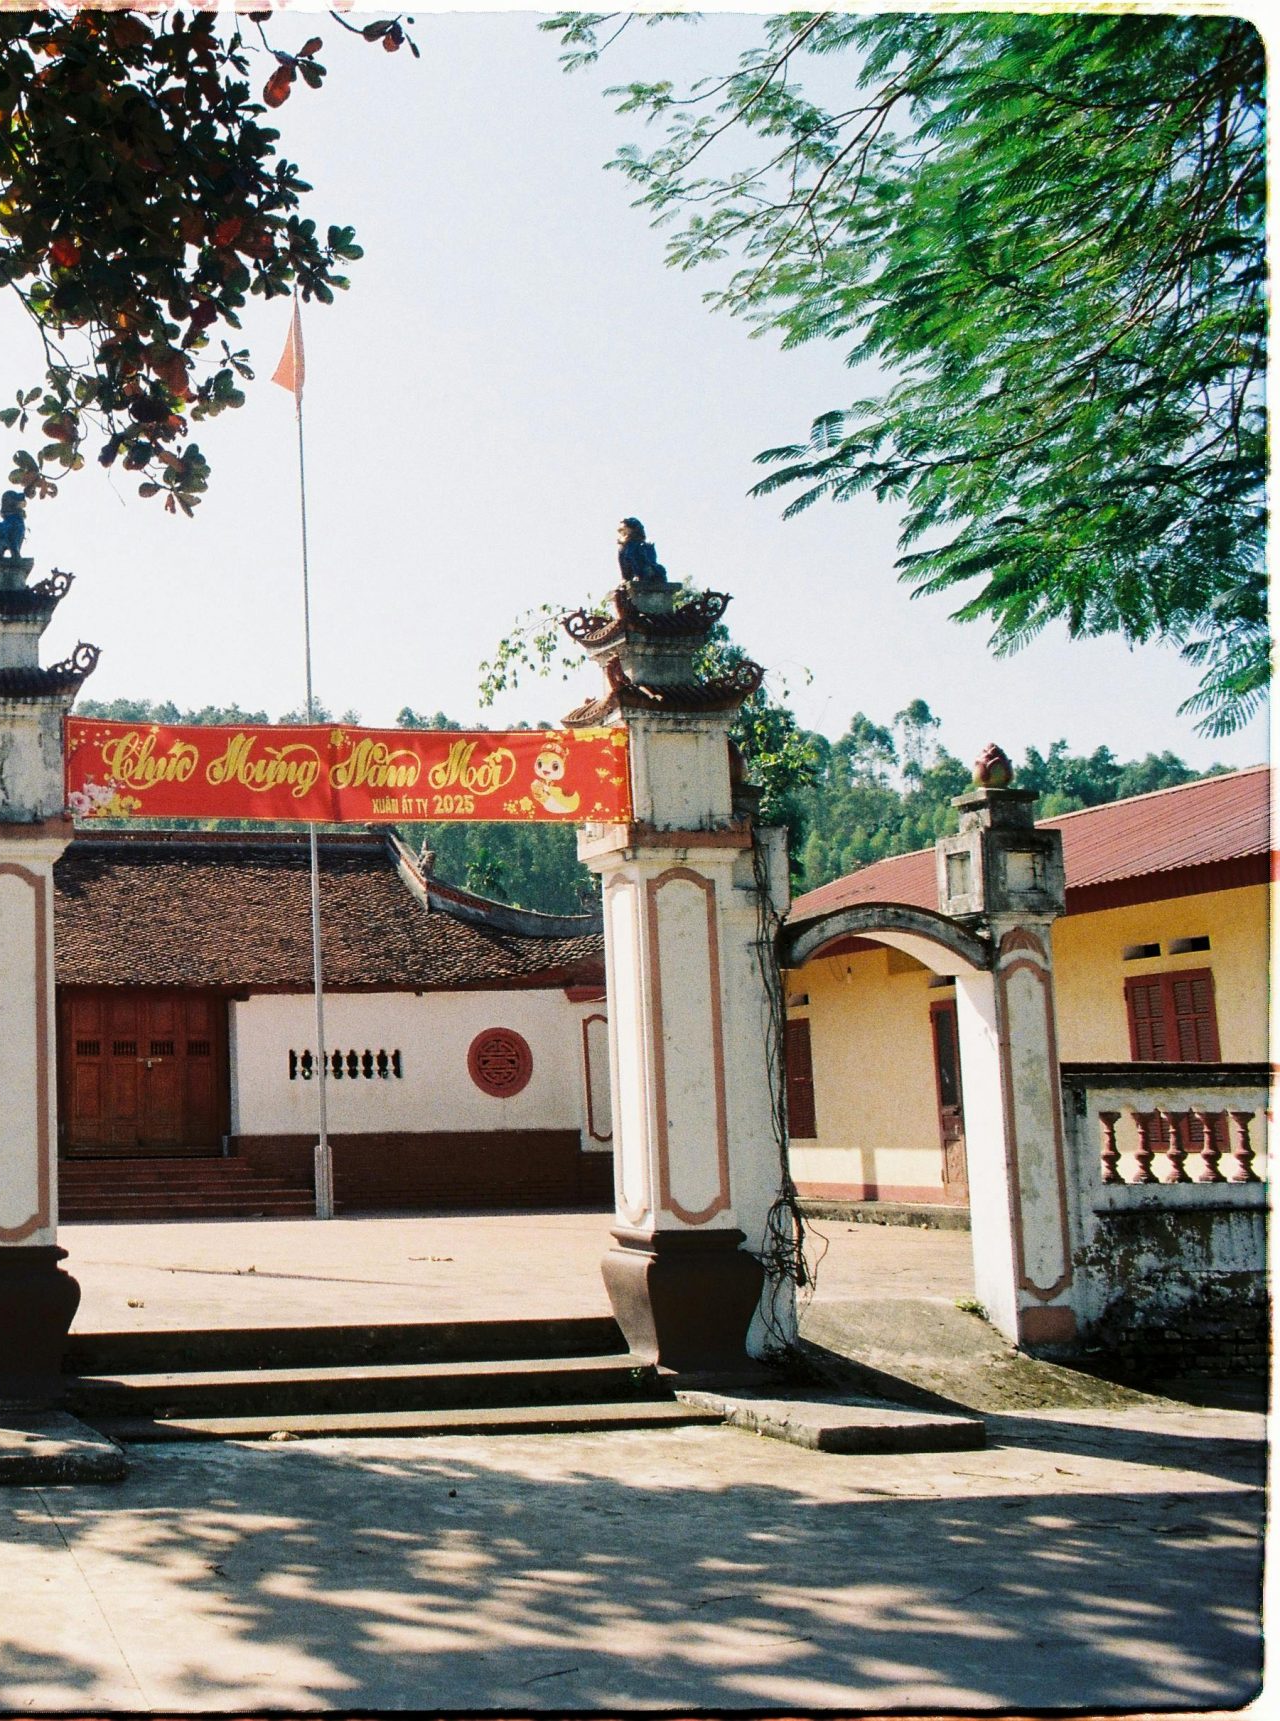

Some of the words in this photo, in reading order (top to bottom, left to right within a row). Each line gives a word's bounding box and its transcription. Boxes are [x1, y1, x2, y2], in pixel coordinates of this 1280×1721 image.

[102, 731, 199, 790] Chúc
[206, 733, 320, 797] Mừng
[329, 738, 421, 790] Năm
[428, 739, 516, 796] Mới
[372, 795, 399, 815] XUÂN
[433, 794, 475, 815] 2025
